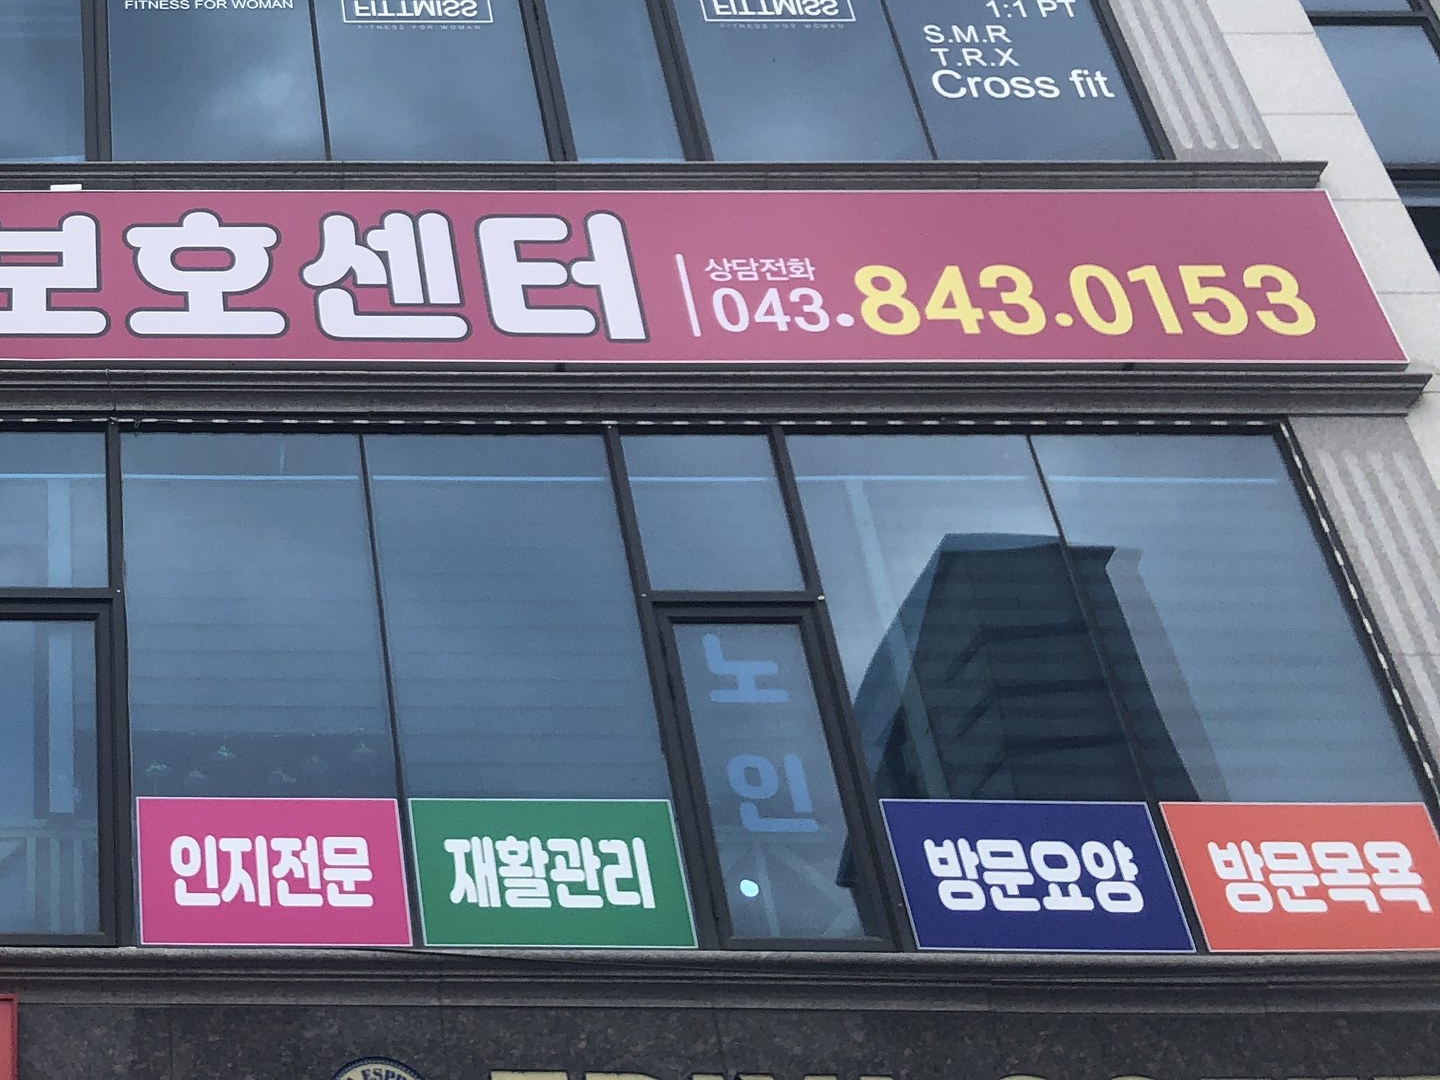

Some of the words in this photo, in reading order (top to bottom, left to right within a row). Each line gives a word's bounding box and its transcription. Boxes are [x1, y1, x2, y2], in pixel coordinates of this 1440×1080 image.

[124, 0, 190, 10] FITNESS
[195, 0, 227, 10] FOR
[231, 0, 293, 10] WOMAN
[985, 0, 1027, 18] 1:1
[1040, 0, 1076, 18] PT
[923, 24, 1012, 44] S.M.R
[930, 48, 1019, 67] T.R.X
[931, 69, 1060, 99] Cross
[1069, 69, 1115, 98] fit
[705, 258, 816, 281] 상담전화
[169, 834, 374, 907] 인지전문
[443, 837, 656, 909] 재활관리
[922, 838, 1139, 913] 방문요양
[1208, 840, 1434, 915] 방문목욕
